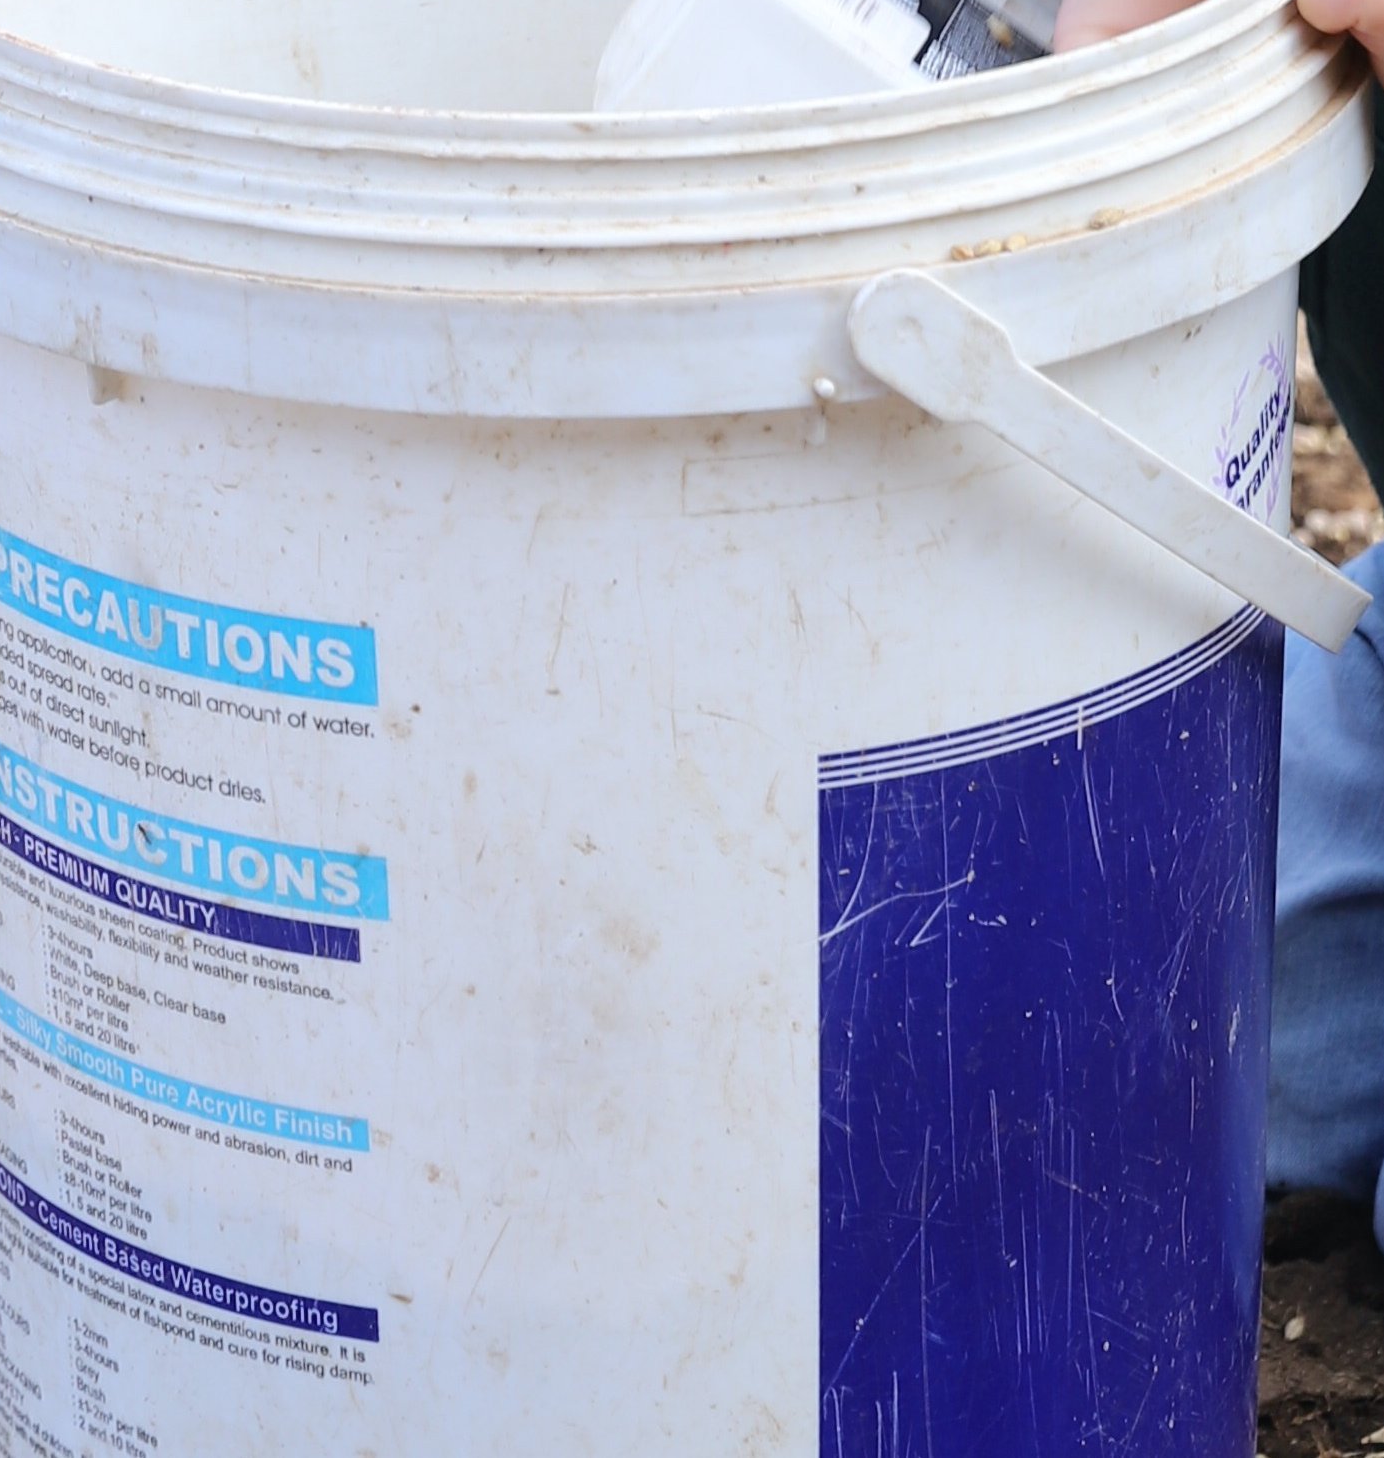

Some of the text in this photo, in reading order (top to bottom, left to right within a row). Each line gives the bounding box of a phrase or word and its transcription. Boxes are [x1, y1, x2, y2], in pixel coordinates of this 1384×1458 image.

[1226, 381, 1281, 489] Quality
[17, 627, 96, 678] application,
[101, 664, 134, 690] add
[139, 678, 151, 695] a
[155, 682, 201, 709] small
[206, 695, 281, 725] amount
[287, 710, 307, 729] of
[313, 717, 375, 739] water.
[27, 654, 72, 696] spread
[77, 680, 110, 708] rate.
[7, 671, 27, 698] out
[30, 683, 42, 706] of
[46, 693, 86, 724] direct
[89, 713, 150, 748] sunlight.
[21, 703, 44, 732] with
[47, 721, 86, 751] water
[89, 741, 141, 773] before
[144, 759, 214, 791] product
[218, 779, 266, 805] dries.
[24, 833, 110, 896] PREMIUM
[116, 878, 215, 928] QUALITY
[28, 869, 45, 891] and
[48, 879, 95, 917] luxurious
[98, 910, 134, 932] sheen
[138, 926, 187, 951] coating.
[193, 937, 247, 966] Product
[251, 954, 300, 975] shows
[47, 924, 94, 959] 3-4hours
[46, 900, 105, 941] washability,
[108, 926, 160, 963] flexibility
[164, 950, 188, 971] and
[193, 960, 248, 986] weather
[253, 972, 334, 1002] resistance.
[50, 943, 226, 1025] White, Deep base, Clear base
[50, 964, 131, 1014] Brush or Roller
[74, 1017, 95, 1038] and
[97, 1024, 113, 1044] 20
[114, 1031, 136, 1054] litre
[86, 1000, 106, 1023] per
[107, 1009, 129, 1032] litre
[16, 1005, 51, 1051] Silky
[56, 1031, 125, 1082] Smooth
[131, 1069, 179, 1104] Pure
[186, 1087, 266, 1127] Acrylic
[275, 1108, 352, 1143] Finish
[43, 1057, 62, 1081] with
[65, 1074, 111, 1105] excellent
[114, 1094, 149, 1125] hiding
[152, 1113, 191, 1137] power
[195, 1124, 220, 1145] and
[224, 1133, 290, 1164] abrasion,
[295, 1149, 319, 1167] dirt
[324, 1157, 353, 1173] and
[59, 1109, 105, 1145] 3-4hours
[61, 1131, 122, 1172] Pastel base
[62, 1149, 92, 1176] Brush
[109, 1173, 143, 1200] Roller
[87, 1204, 107, 1224] and
[109, 1213, 124, 1232] 20
[126, 1219, 148, 1241] litre
[109, 1195, 128, 1216] per
[130, 1202, 152, 1224] litre
[38, 1200, 100, 1256] Cement
[105, 1239, 164, 1283] Based
[171, 1265, 339, 1334] Waterproofing
[61, 1267, 74, 1286] for
[77, 1277, 127, 1315] treatment
[143, 1307, 195, 1342] fishpond
[199, 1331, 224, 1352] and
[228, 1342, 258, 1361] cure
[262, 1347, 281, 1367] for
[285, 1355, 326, 1379] rising
[329, 1364, 376, 1385] damp.
[87, 1268, 125, 1296] special
[127, 1282, 155, 1307] latex
[159, 1297, 182, 1318] and
[186, 1310, 271, 1344] cementitious
[275, 1333, 333, 1360] mixture.
[340, 1344, 350, 1363] It
[353, 1346, 366, 1364] is
[75, 1357, 100, 1384] Grey
[77, 1376, 106, 1404] Brush
[87, 1424, 107, 1443] and
[110, 1433, 123, 1451] 10
[116, 1417, 135, 1437] per
[136, 1425, 158, 1448] litre
